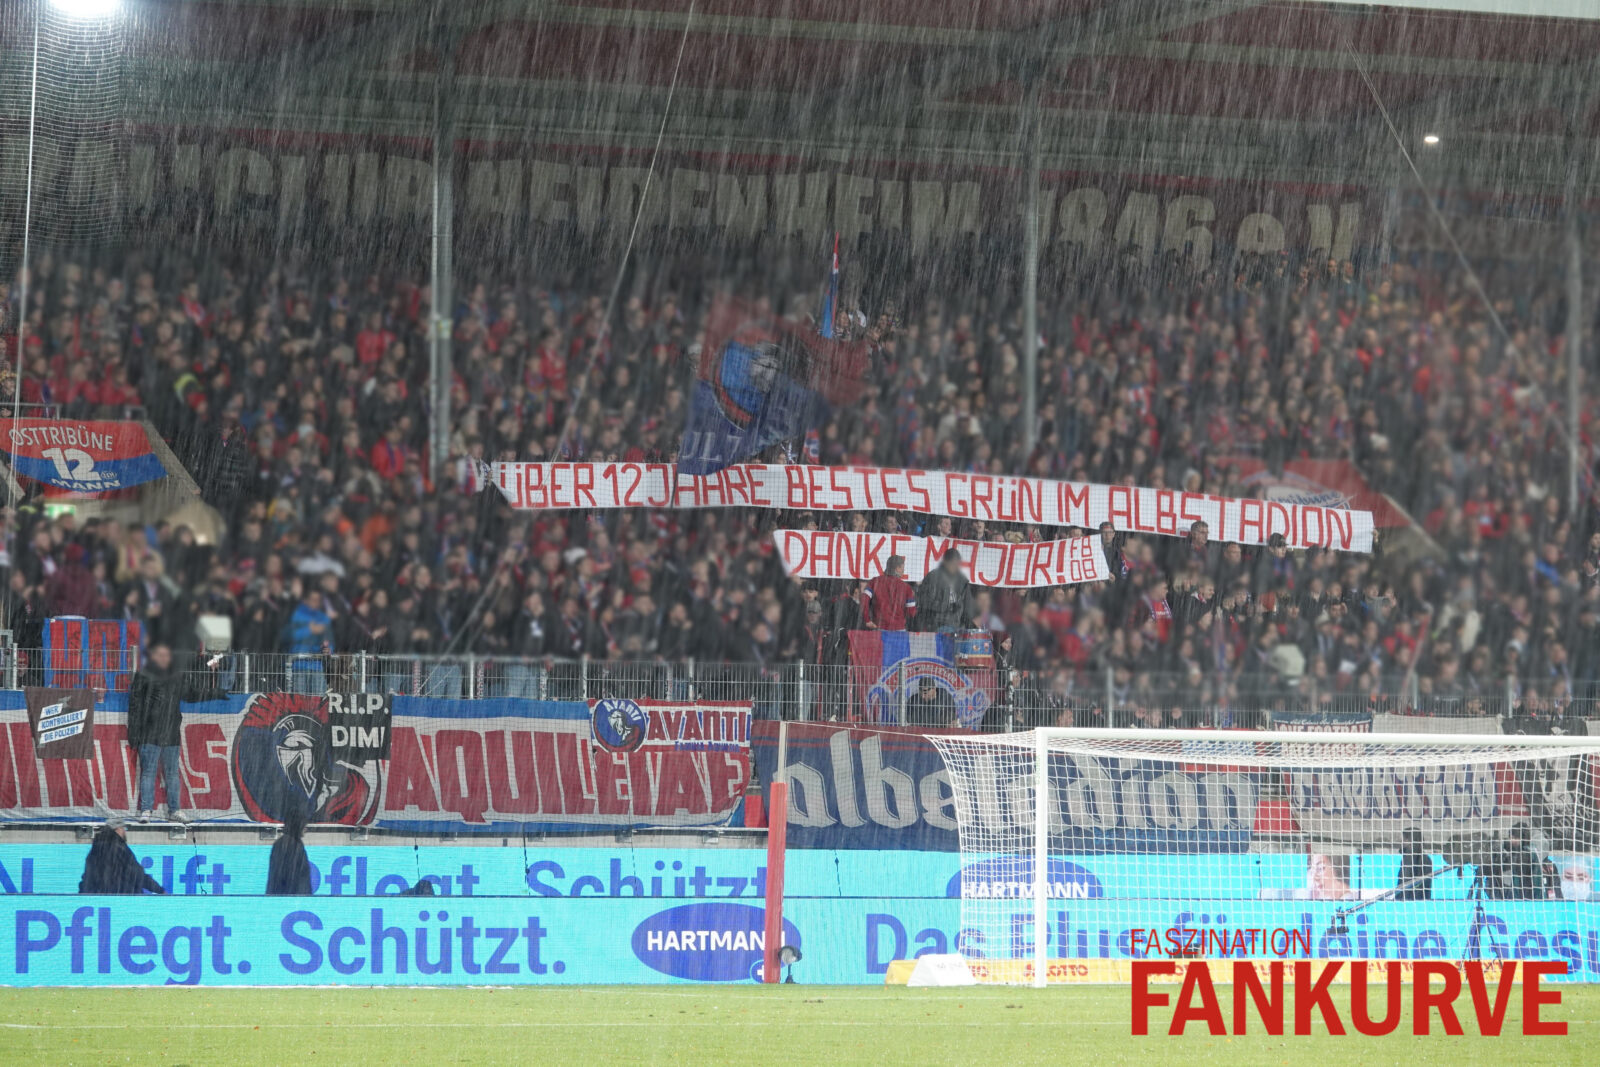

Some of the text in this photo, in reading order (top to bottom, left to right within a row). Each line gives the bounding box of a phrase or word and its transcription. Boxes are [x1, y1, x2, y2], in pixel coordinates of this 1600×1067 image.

[8, 425, 114, 451] OSTTRIBÜNE
[51, 478, 120, 489] MANN
[500, 462, 597, 508] ÜBER
[603, 463, 642, 508] 12
[647, 463, 771, 508] JAHRE
[787, 466, 931, 513] BESTES
[945, 472, 1043, 522] GRÜN
[1058, 482, 1091, 527] IM
[1108, 486, 1353, 552] ALBSTADION
[784, 530, 911, 580] DANKE
[45, 705, 59, 715] WER
[328, 693, 389, 714] R.I.P.
[602, 699, 642, 722] AVANTI
[41, 712, 84, 729] KONTROLLIERT
[647, 710, 748, 742] AVANTI
[44, 733, 54, 742] DIE
[331, 725, 385, 748] DIMI
[15, 906, 566, 985] Pflegt. Schützt.
[647, 930, 785, 952] HARTMAN
[866, 913, 986, 974] Das
[1010, 911, 1149, 959] Plus
[1279, 912, 1448, 959] deine
[1471, 914, 1600, 976] Ges
[1046, 965, 1088, 976] OTTO
